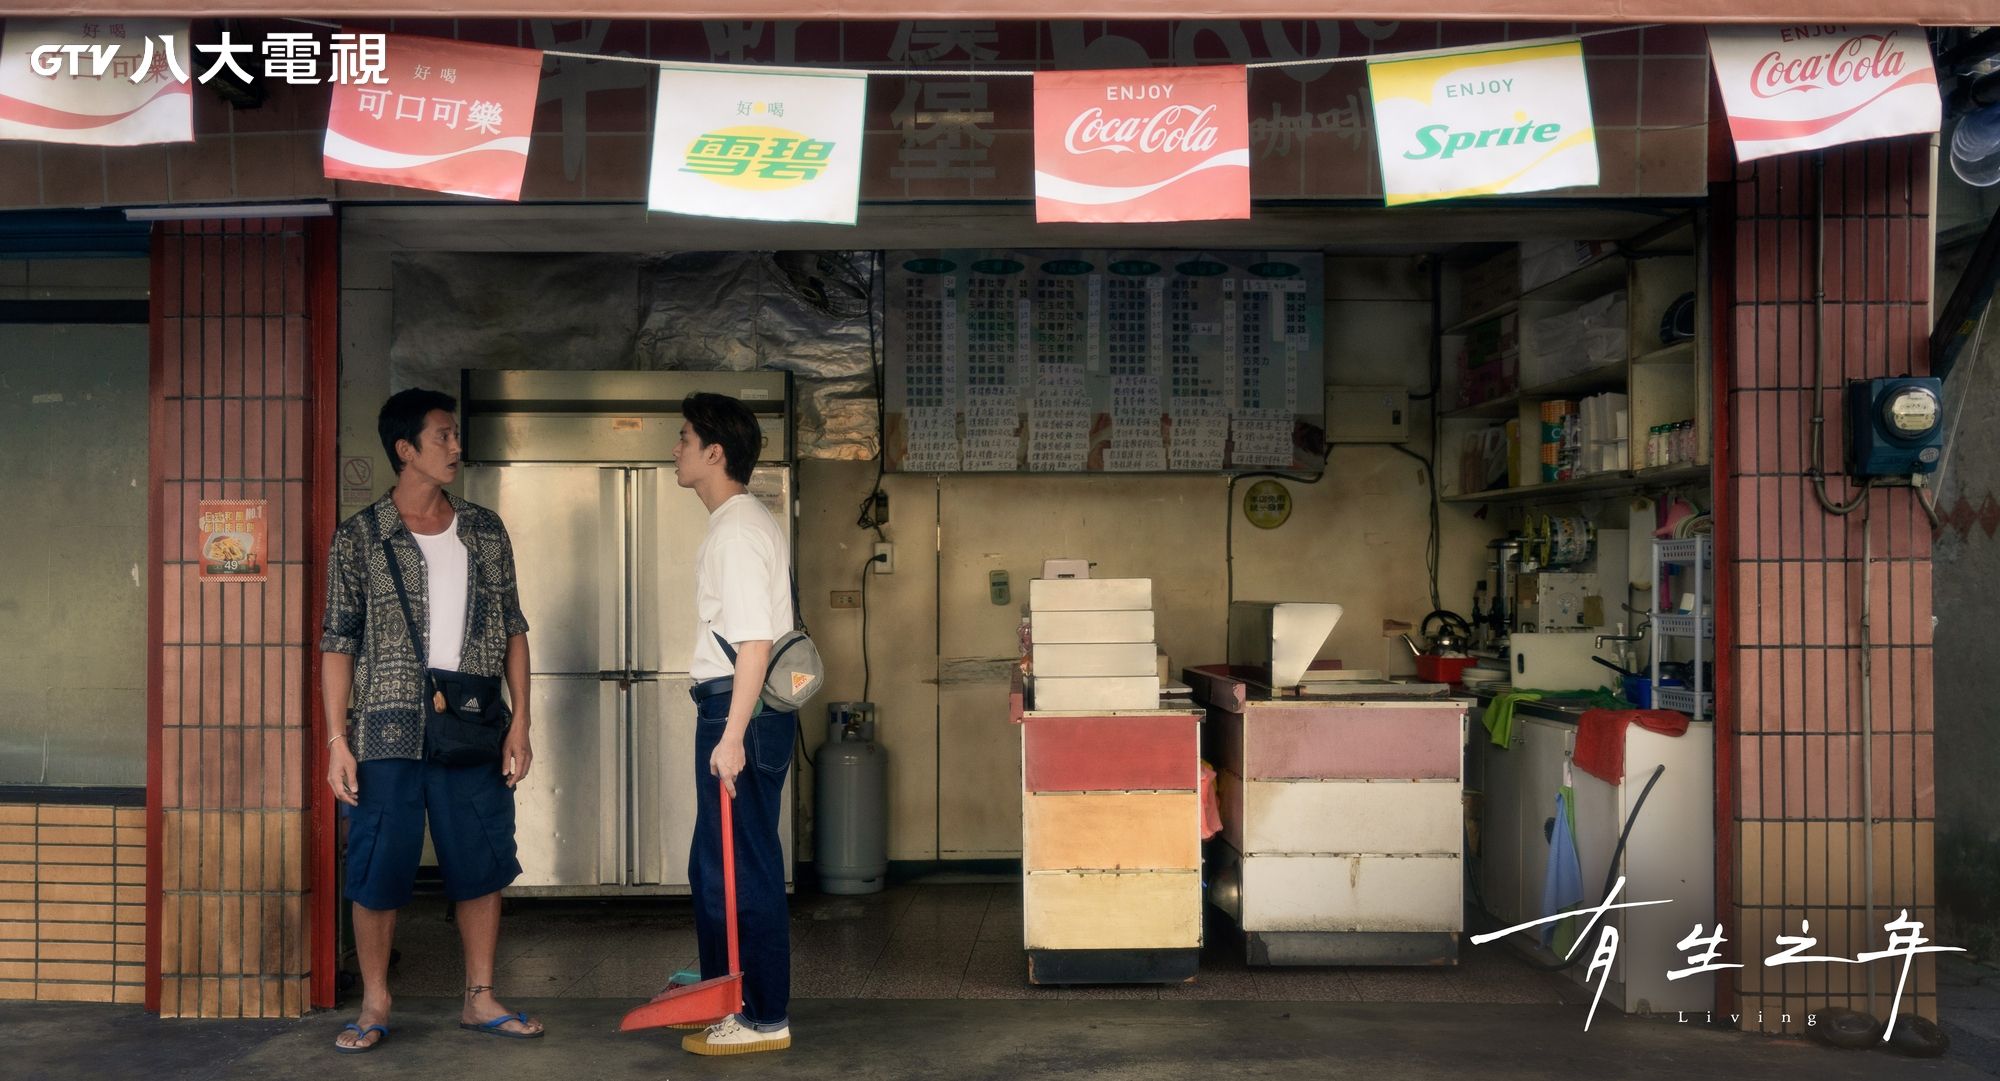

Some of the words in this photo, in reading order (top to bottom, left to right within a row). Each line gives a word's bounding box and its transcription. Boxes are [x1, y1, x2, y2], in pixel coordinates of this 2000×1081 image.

[413, 64, 457, 84] 好喝
[1750, 31, 1906, 99] Coca-Cola
[1106, 84, 1175, 101] ENJOY
[1445, 79, 1514, 98] ENJOY
[357, 89, 503, 135] 可口可樂
[736, 100, 786, 118] 好喝
[1064, 105, 1220, 154] Coca-Cola
[1403, 111, 1561, 161] Sprite
[677, 133, 837, 181] 雪碧
[224, 560, 239, 571] 49
